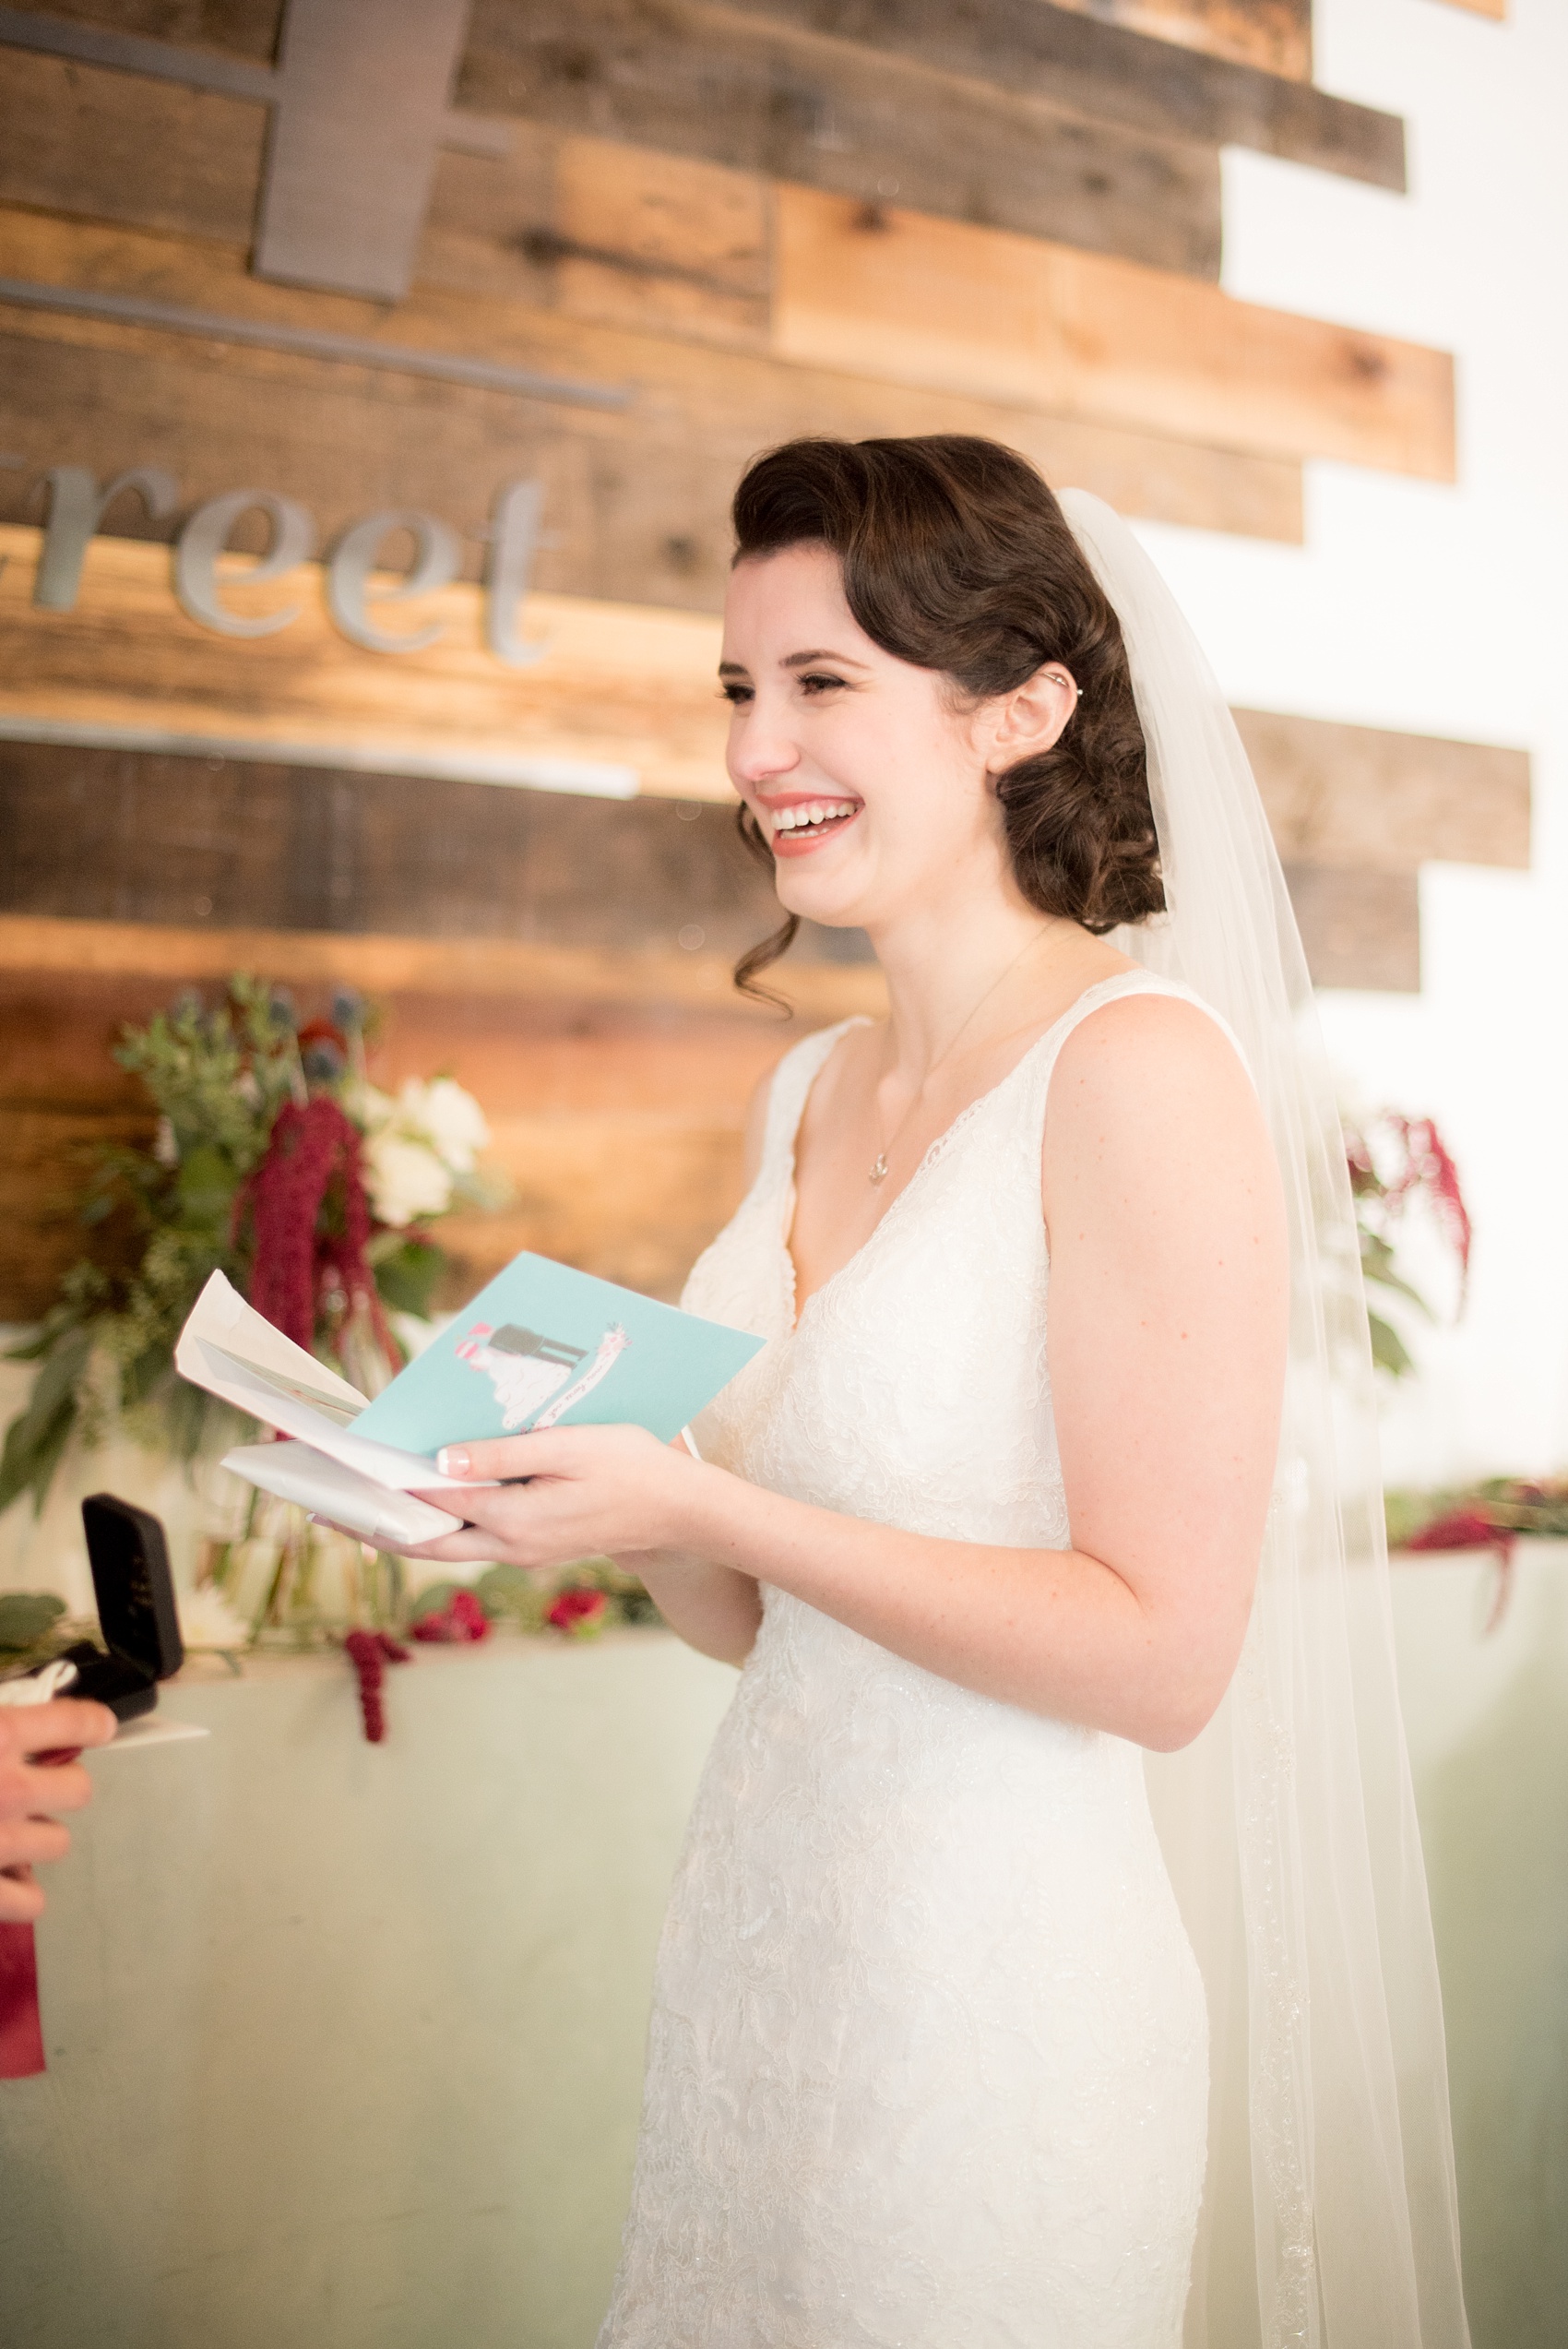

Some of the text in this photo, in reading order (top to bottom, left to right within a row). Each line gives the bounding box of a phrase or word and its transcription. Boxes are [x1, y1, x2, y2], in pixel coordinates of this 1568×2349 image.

[0, 449, 563, 668] reet
[549, 1403, 562, 1418] you
[565, 1384, 586, 1401] may
